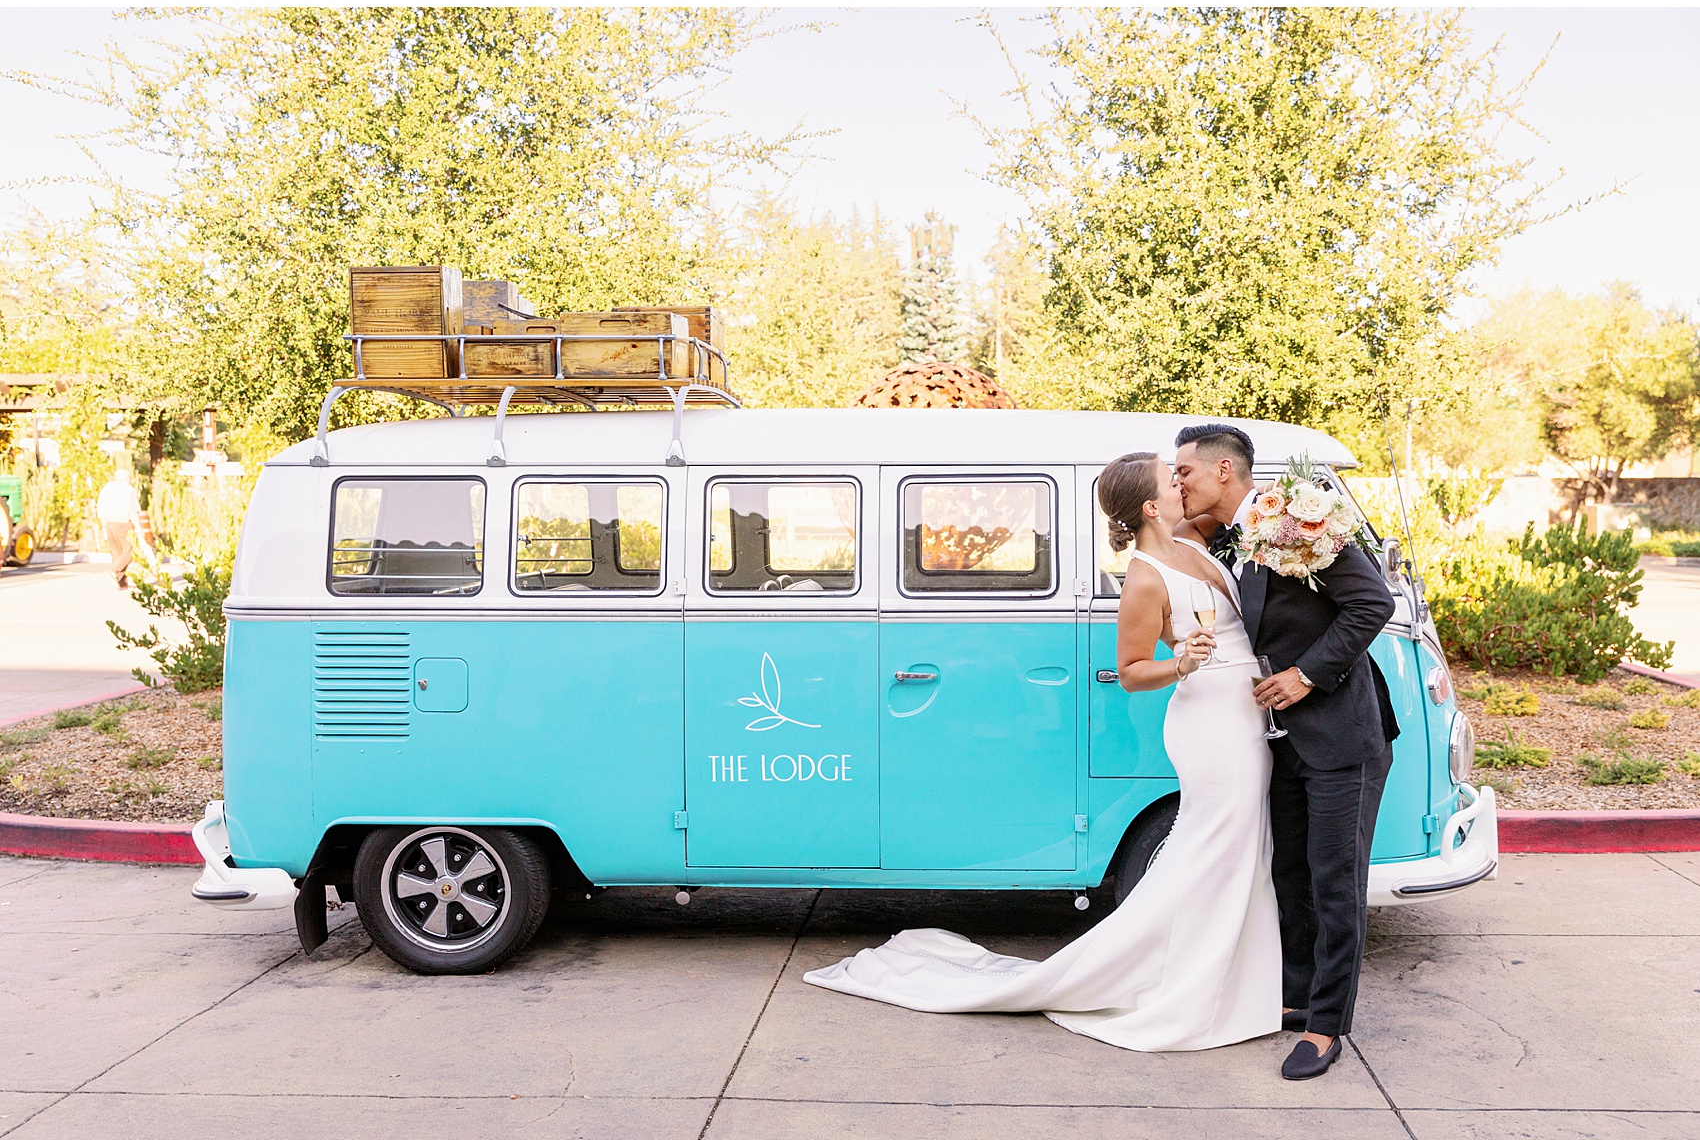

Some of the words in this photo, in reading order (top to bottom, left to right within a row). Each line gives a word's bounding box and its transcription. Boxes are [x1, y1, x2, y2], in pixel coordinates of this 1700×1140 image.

[364, 308, 391, 318] PAUL
[708, 755, 748, 782] THE
[761, 754, 852, 782] LODGE
